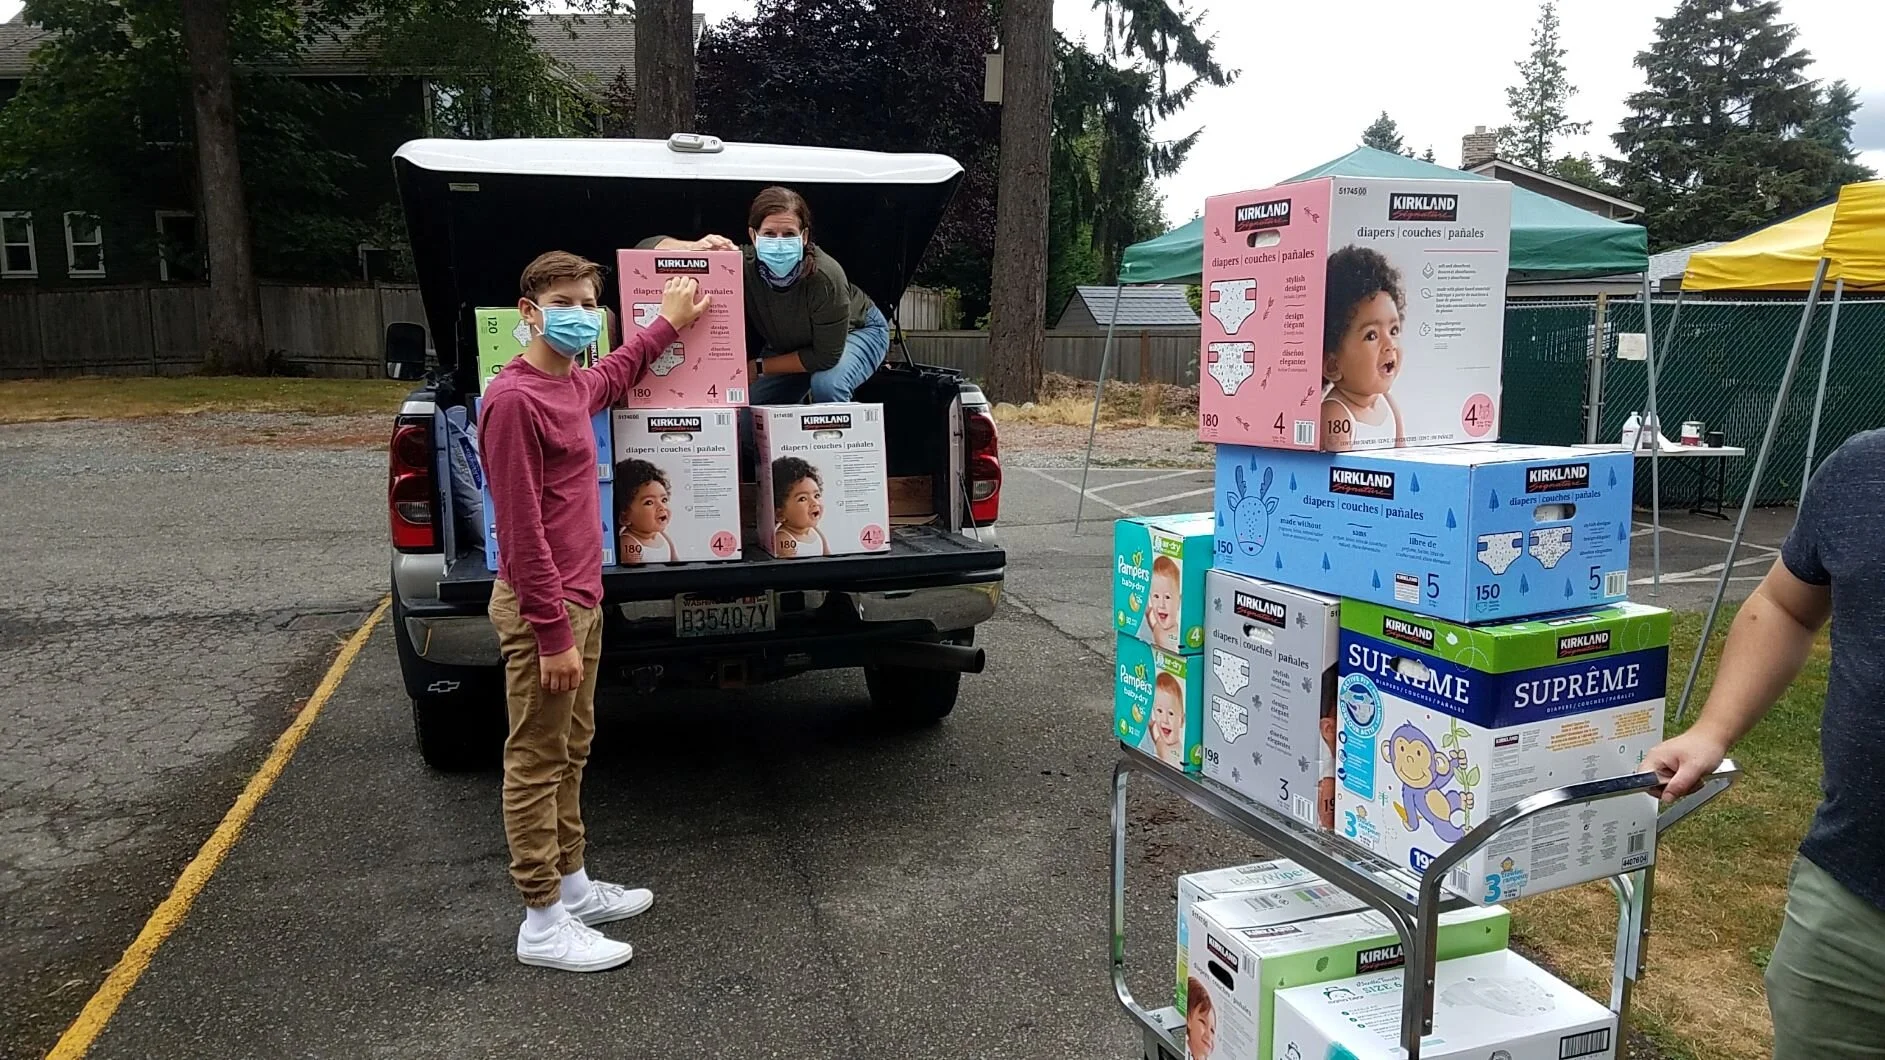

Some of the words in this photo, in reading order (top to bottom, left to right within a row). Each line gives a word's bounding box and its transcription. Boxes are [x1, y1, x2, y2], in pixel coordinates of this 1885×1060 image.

[1339, 187, 1367, 196] 5174500
[1393, 196, 1456, 211] KIRKLAND
[1238, 202, 1289, 221] KIRKLAND
[1392, 209, 1453, 221] Signature
[1357, 227, 1395, 240] diapers
[1402, 227, 1442, 238] couches
[1448, 227, 1484, 240] pañales
[658, 260, 707, 269] KIRKLAND
[1212, 256, 1240, 269] diapers
[1245, 252, 1276, 265] couches
[1282, 249, 1315, 263] pañales
[1286, 275, 1305, 284] stylish
[633, 288, 663, 296] diapers
[704, 288, 734, 296] pañales
[1285, 284, 1306, 293] designs
[1285, 312, 1304, 321] design
[488, 317, 498, 334] 120
[1280, 358, 1306, 366] elegantes
[633, 388, 651, 397] 180
[707, 384, 718, 399] 4
[651, 418, 700, 427] KIRKLAND
[804, 415, 850, 425] KIRKLAND
[1202, 414, 1219, 427] 180
[1464, 404, 1478, 426] 4
[1274, 412, 1286, 435] 4
[1327, 419, 1351, 434] 180
[626, 446, 656, 454] diapers
[696, 445, 726, 454] pañales
[781, 444, 808, 452] diapers
[813, 442, 842, 450] couches
[847, 441, 874, 450] pañales
[1332, 469, 1393, 489] KIRKLAND
[1530, 466, 1588, 483] KIRKLAND
[1332, 482, 1391, 496] Signature
[1529, 481, 1587, 493] Signature
[1510, 497, 1537, 507] diapers
[1542, 493, 1571, 503] couches
[1575, 490, 1601, 502] pañales
[1303, 495, 1336, 512] diapers
[1341, 500, 1380, 515] couches
[1385, 505, 1424, 521] pañales
[1280, 518, 1297, 526] made
[1297, 521, 1322, 530] without
[862, 530, 872, 544] 4
[1352, 530, 1367, 538] sans
[625, 545, 643, 554] 180
[713, 538, 724, 551] 4
[780, 540, 797, 549] 180
[1217, 540, 1234, 555] 150
[1409, 538, 1427, 548] libre
[1427, 540, 1437, 549] de
[1118, 555, 1150, 582] Pampers
[1122, 577, 1145, 593] baby-dry
[1427, 573, 1440, 599] 5
[1589, 566, 1601, 591] 5
[1476, 584, 1500, 601] 150
[1237, 593, 1284, 618] KIRKLAND
[682, 604, 769, 632] B35407Y
[1192, 626, 1200, 642] 4
[1386, 618, 1433, 641] KIRKLAND
[1561, 633, 1609, 650] KIRKLAND
[1213, 629, 1239, 646] diapers
[1243, 640, 1273, 657] couches
[1278, 652, 1310, 670] pañales
[1120, 664, 1153, 696] Pampers
[1343, 676, 1360, 691] ACTIVE
[1514, 663, 1640, 709] SUPRÊME
[1124, 686, 1149, 705] baby-dry
[1195, 747, 1202, 757] 4
[1205, 747, 1219, 765] 198
[1279, 778, 1289, 801] 3
[1324, 800, 1335, 812] 19
[1345, 810, 1358, 838] 3
[1414, 851, 1434, 870] 19
[1484, 874, 1501, 903] 3
[1209, 936, 1238, 966] KIRKLAND
[1361, 945, 1404, 965] KIRKLA
[1194, 962, 1210, 982] diapers
[1213, 979, 1231, 998] couches
[1233, 995, 1252, 1017] pañales
[1363, 984, 1392, 994] SIZE
